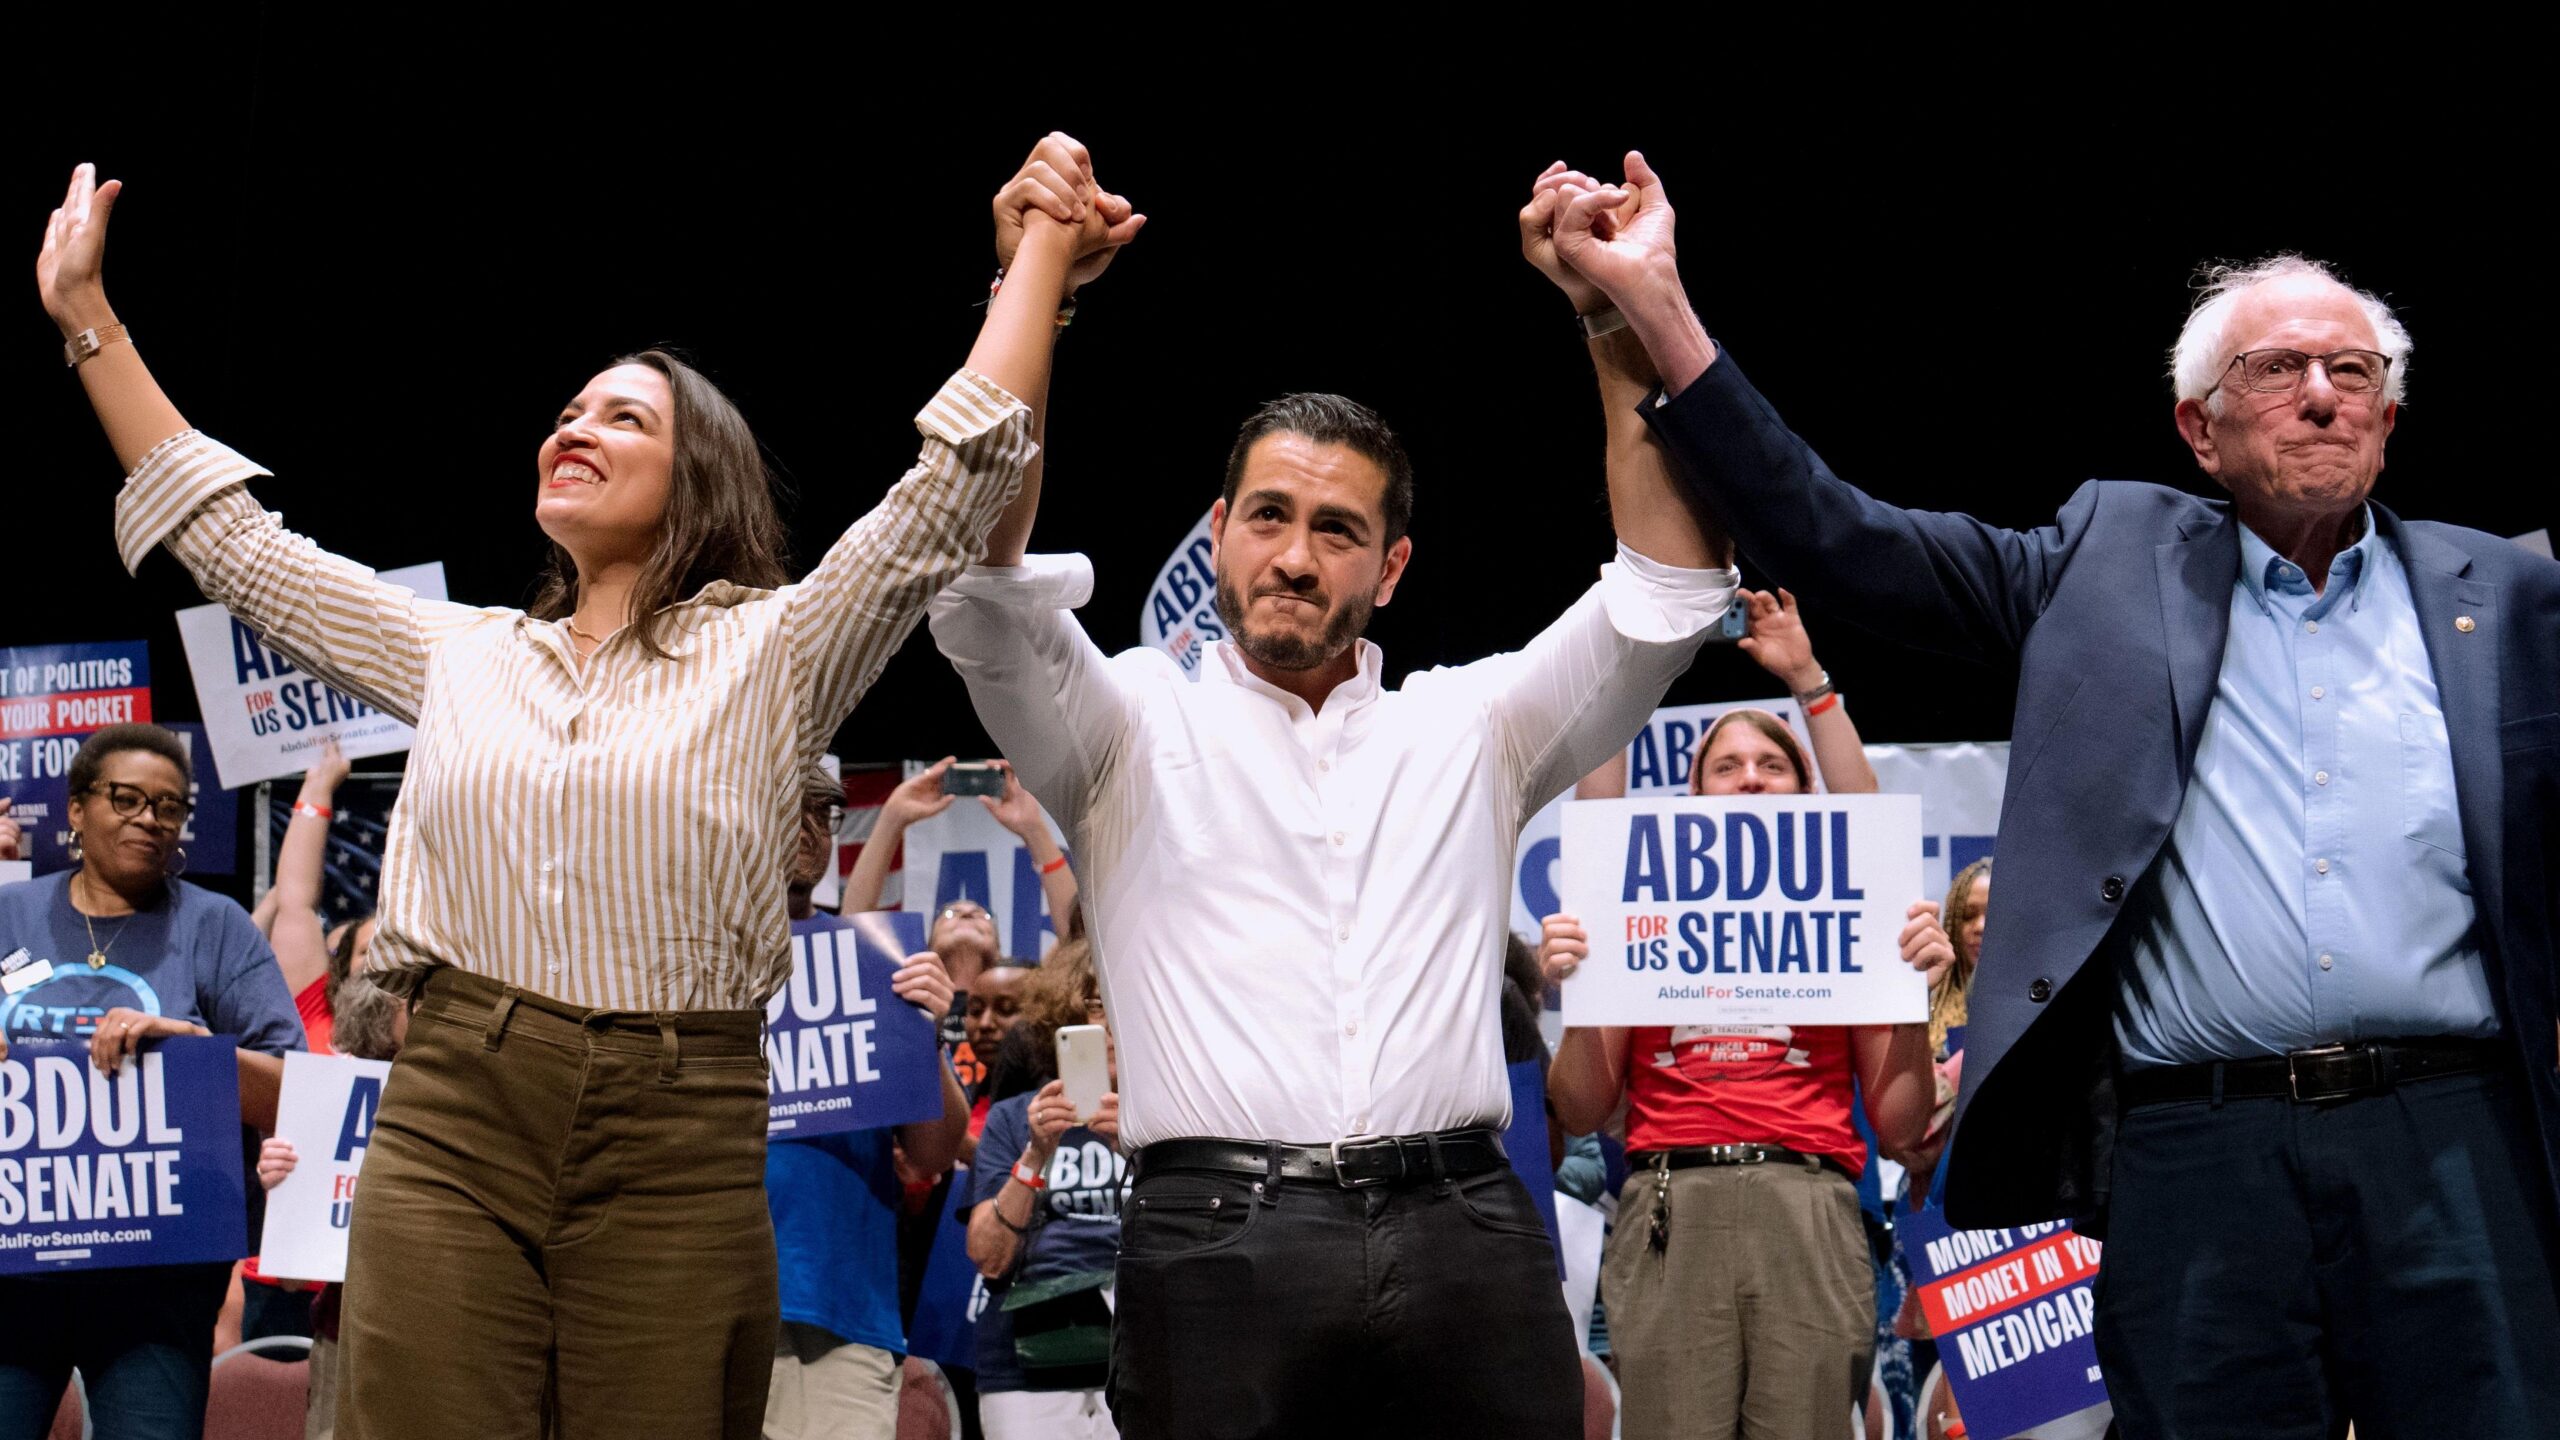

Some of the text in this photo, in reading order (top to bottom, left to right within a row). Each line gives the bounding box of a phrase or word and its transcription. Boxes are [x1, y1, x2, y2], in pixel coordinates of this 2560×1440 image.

[16, 666, 38, 694] OF
[44, 658, 132, 693] POLITICS
[1, 694, 133, 732] YOUR POCKET
[245, 691, 275, 714] FOR
[251, 708, 281, 736] US
[1621, 811, 1864, 902] ABDUL
[1626, 915, 1667, 943] FOR
[1626, 910, 1863, 974] US SENATE
[1658, 985, 1832, 999] AbdulForSenate.com
[1718, 1026, 1758, 1034] TEACHERS
[0, 1150, 184, 1225] SENATE
[1925, 1228, 2014, 1276] MONEY
[1941, 1258, 2029, 1321] MONEY
[2031, 1246, 2064, 1286] IN
